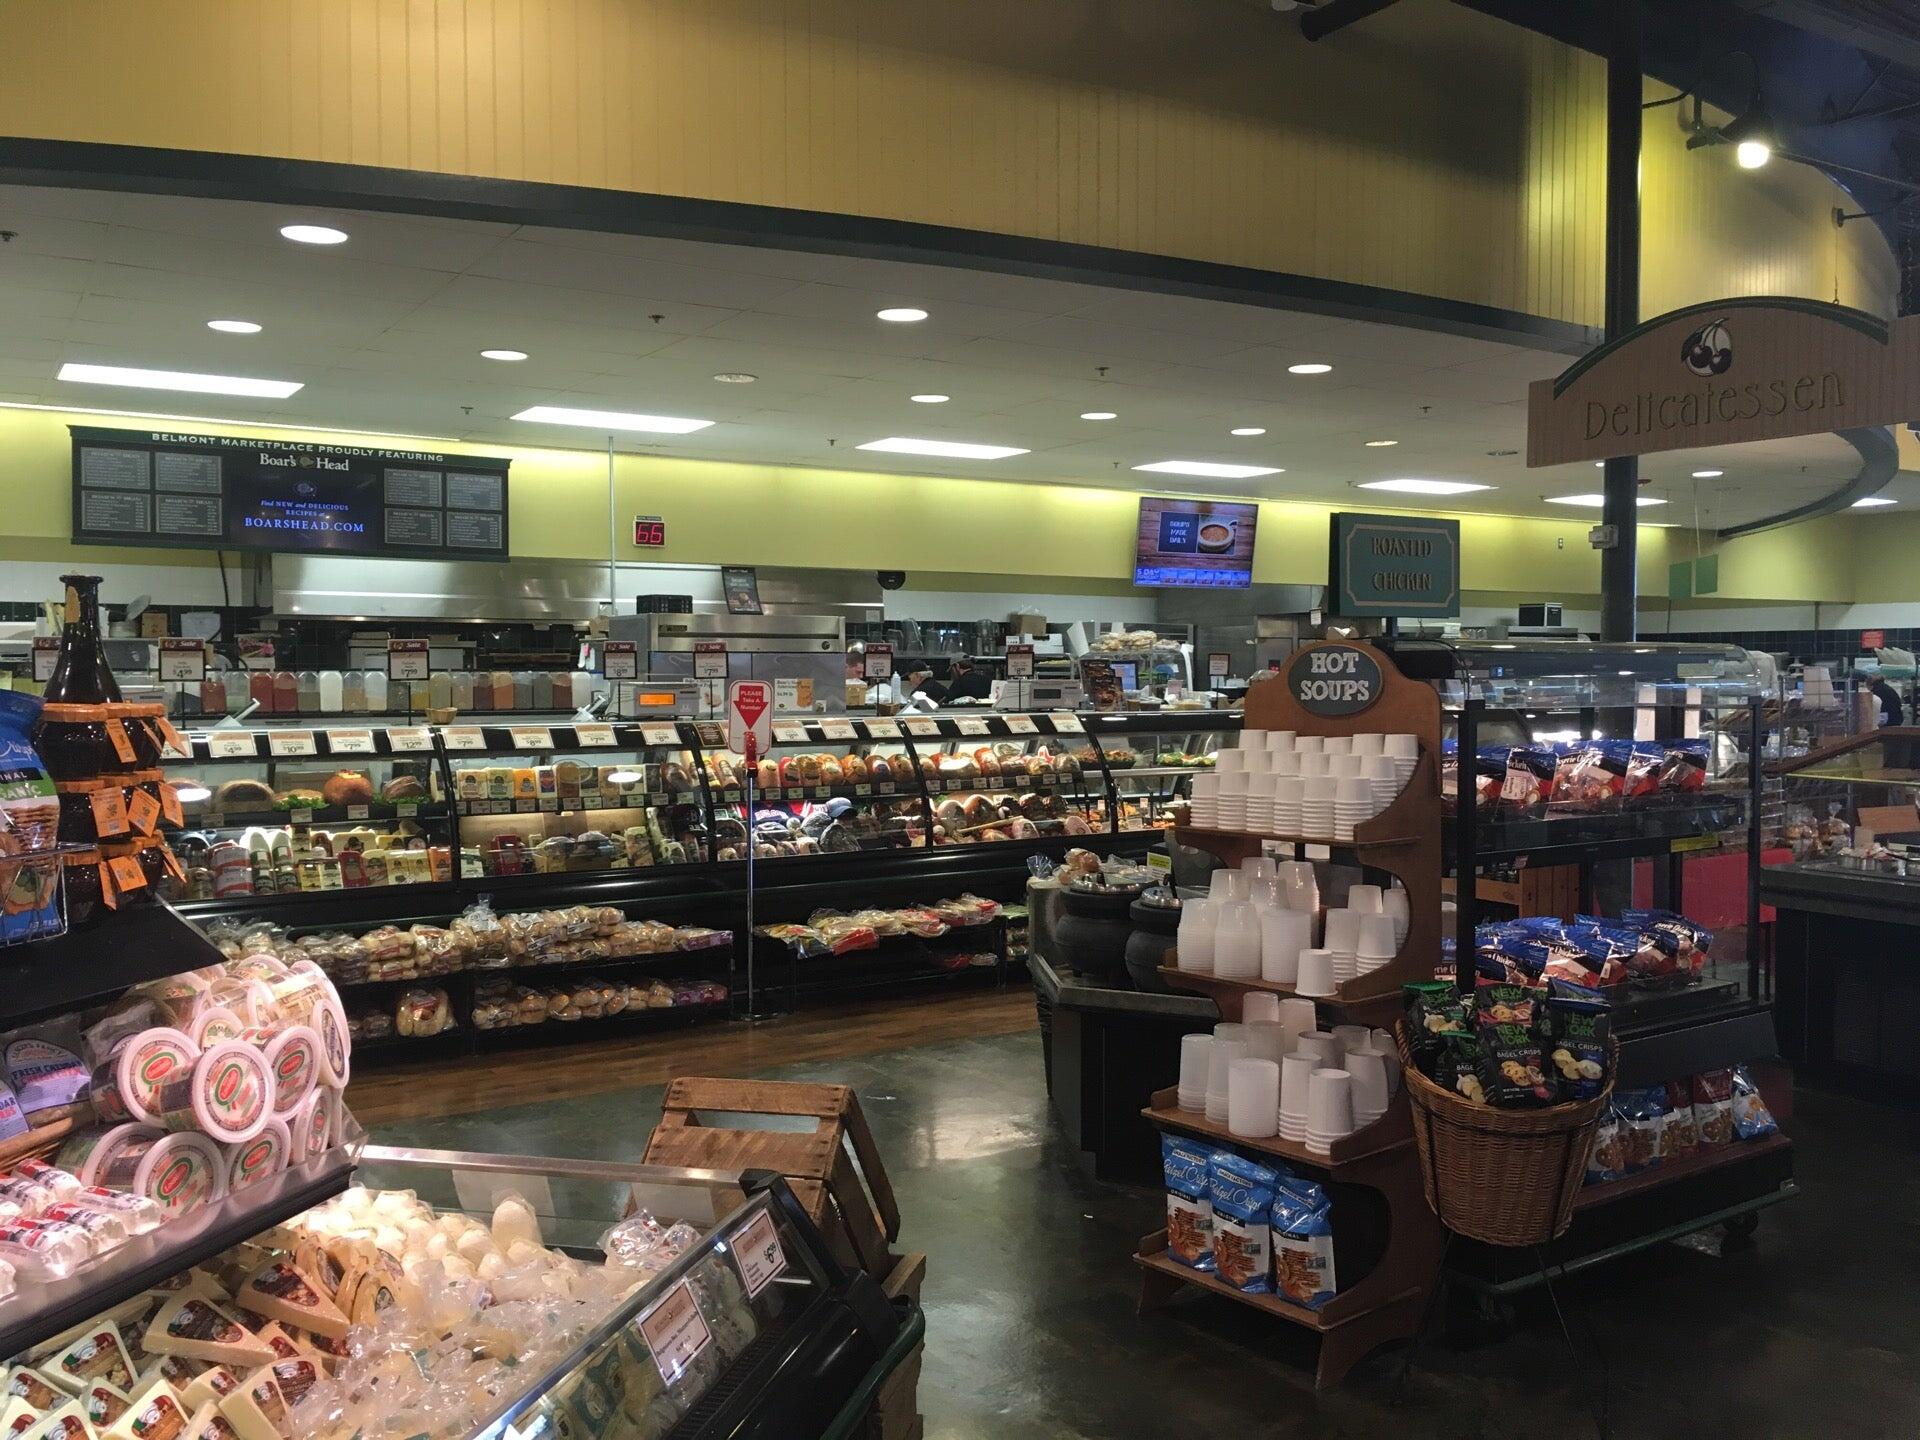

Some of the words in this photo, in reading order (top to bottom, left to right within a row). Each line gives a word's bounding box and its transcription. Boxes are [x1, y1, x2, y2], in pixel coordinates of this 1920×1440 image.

[1583, 371, 1846, 441] Delicatessen
[151, 433, 216, 445] BELMONT
[221, 439, 313, 452] MARKETPLACE
[318, 445, 374, 457] PROUDLY
[378, 450, 444, 462] FEATURING
[260, 453, 297, 467] Boar's
[316, 457, 350, 471] Head
[285, 509, 317, 517] RECIPES
[308, 503, 349, 511] DELICIOUS
[245, 517, 364, 532] BOARSHEAD.COM
[637, 523, 663, 543] 66
[1372, 536, 1434, 558] ROASTED
[1372, 571, 1432, 591] CHICKEN
[1310, 652, 1359, 674] HOT
[1300, 679, 1370, 702] SOUPS
[1491, 987, 1523, 1000] NEW
[1496, 1024, 1527, 1036] NEW
[1496, 1050, 1517, 1059] BAGEL
[1518, 1048, 1542, 1058] CRISPS
[1577, 1043, 1603, 1052] CRISPS
[1456, 1064, 1474, 1072] BAGE
[1186, 1167, 1208, 1190] Crisp
